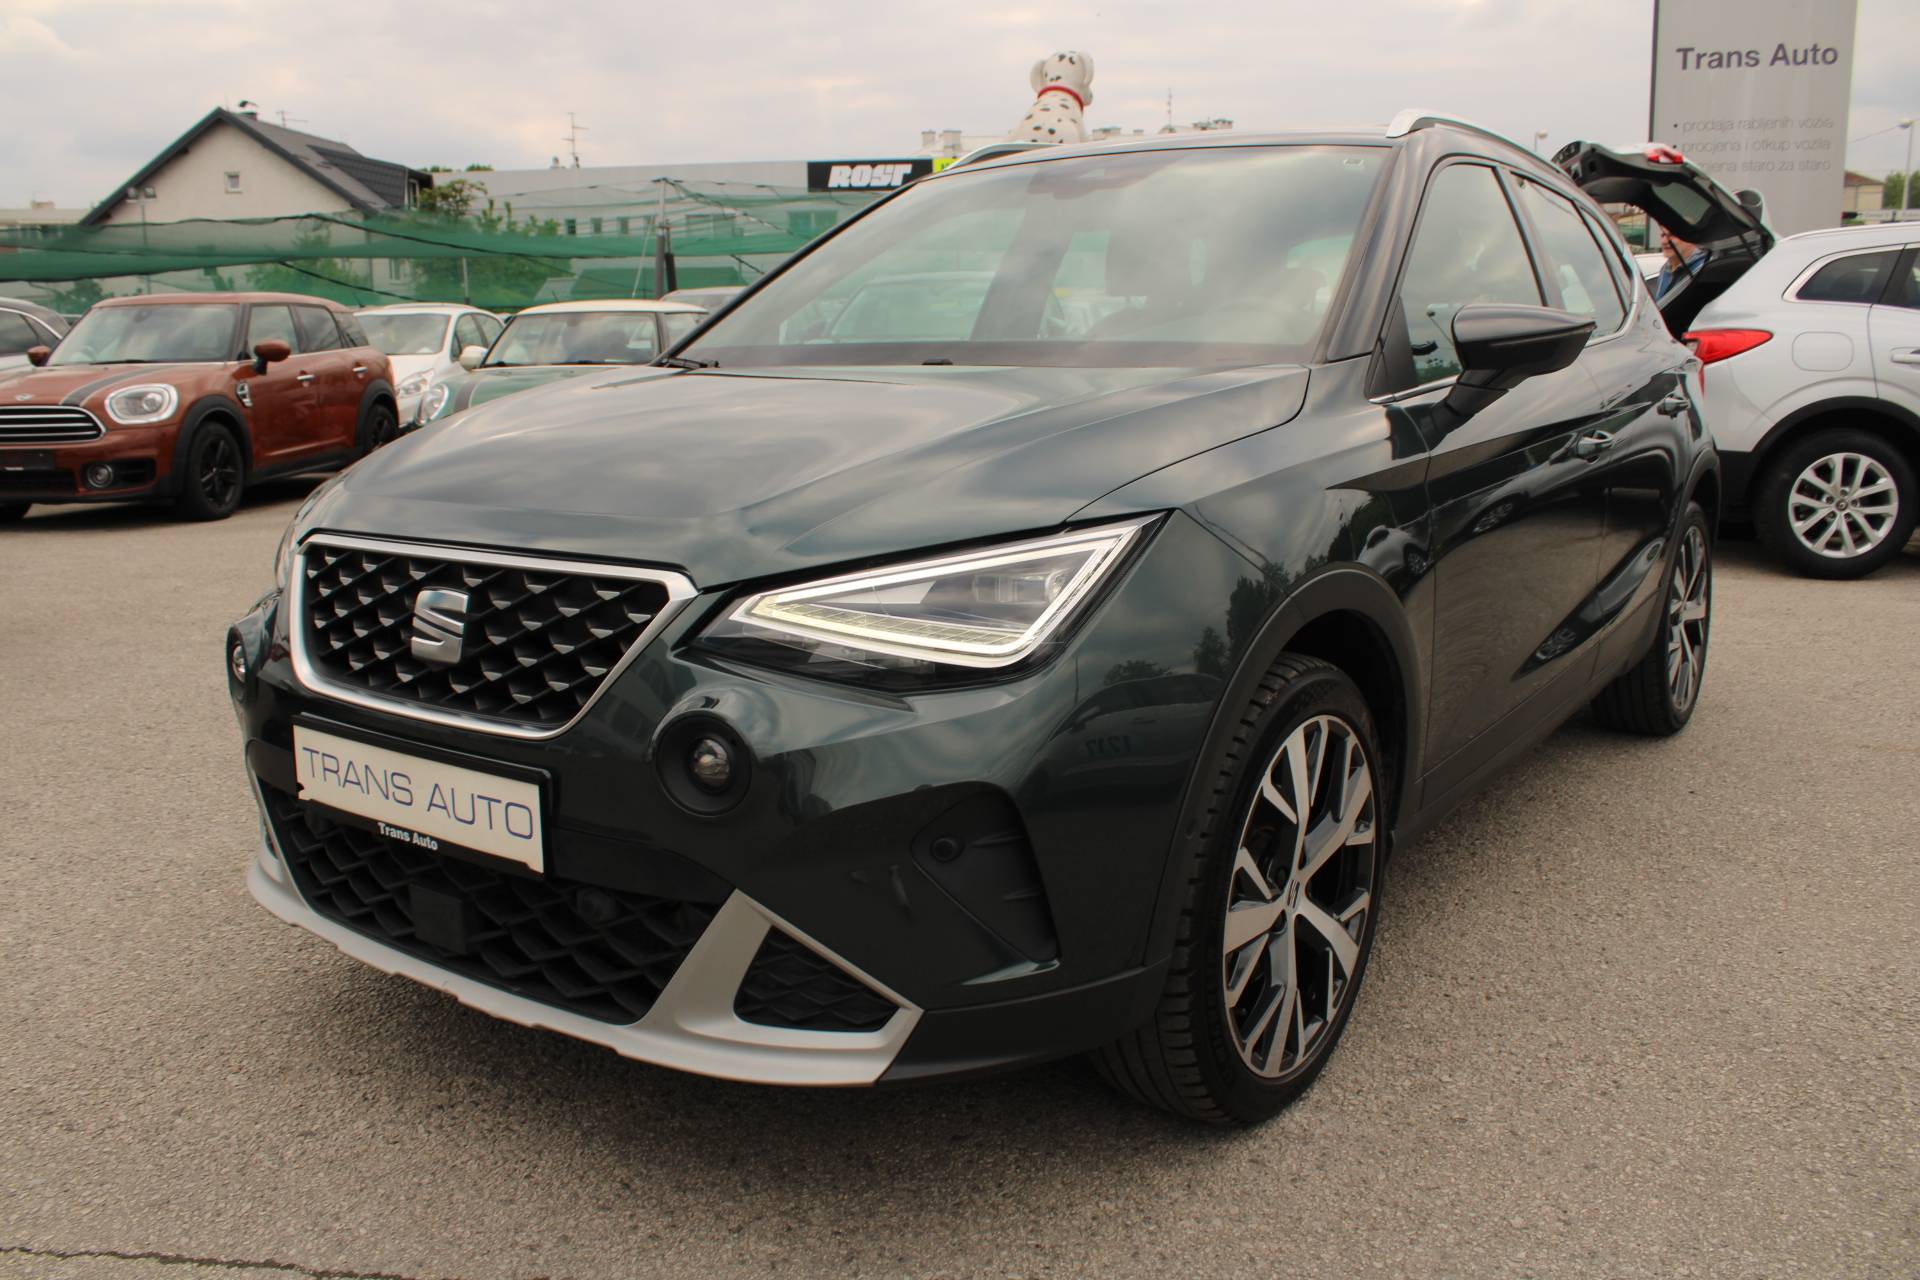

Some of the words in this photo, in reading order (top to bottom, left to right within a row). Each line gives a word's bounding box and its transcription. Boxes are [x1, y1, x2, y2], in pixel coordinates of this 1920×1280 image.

[1676, 46, 1761, 71] Trans
[1769, 43, 1839, 67] Auto
[828, 163, 913, 188] ROST
[302, 747, 414, 807] TRANS
[427, 783, 534, 840] AUTO
[377, 821, 411, 842] Trans
[412, 831, 438, 850] Auto
